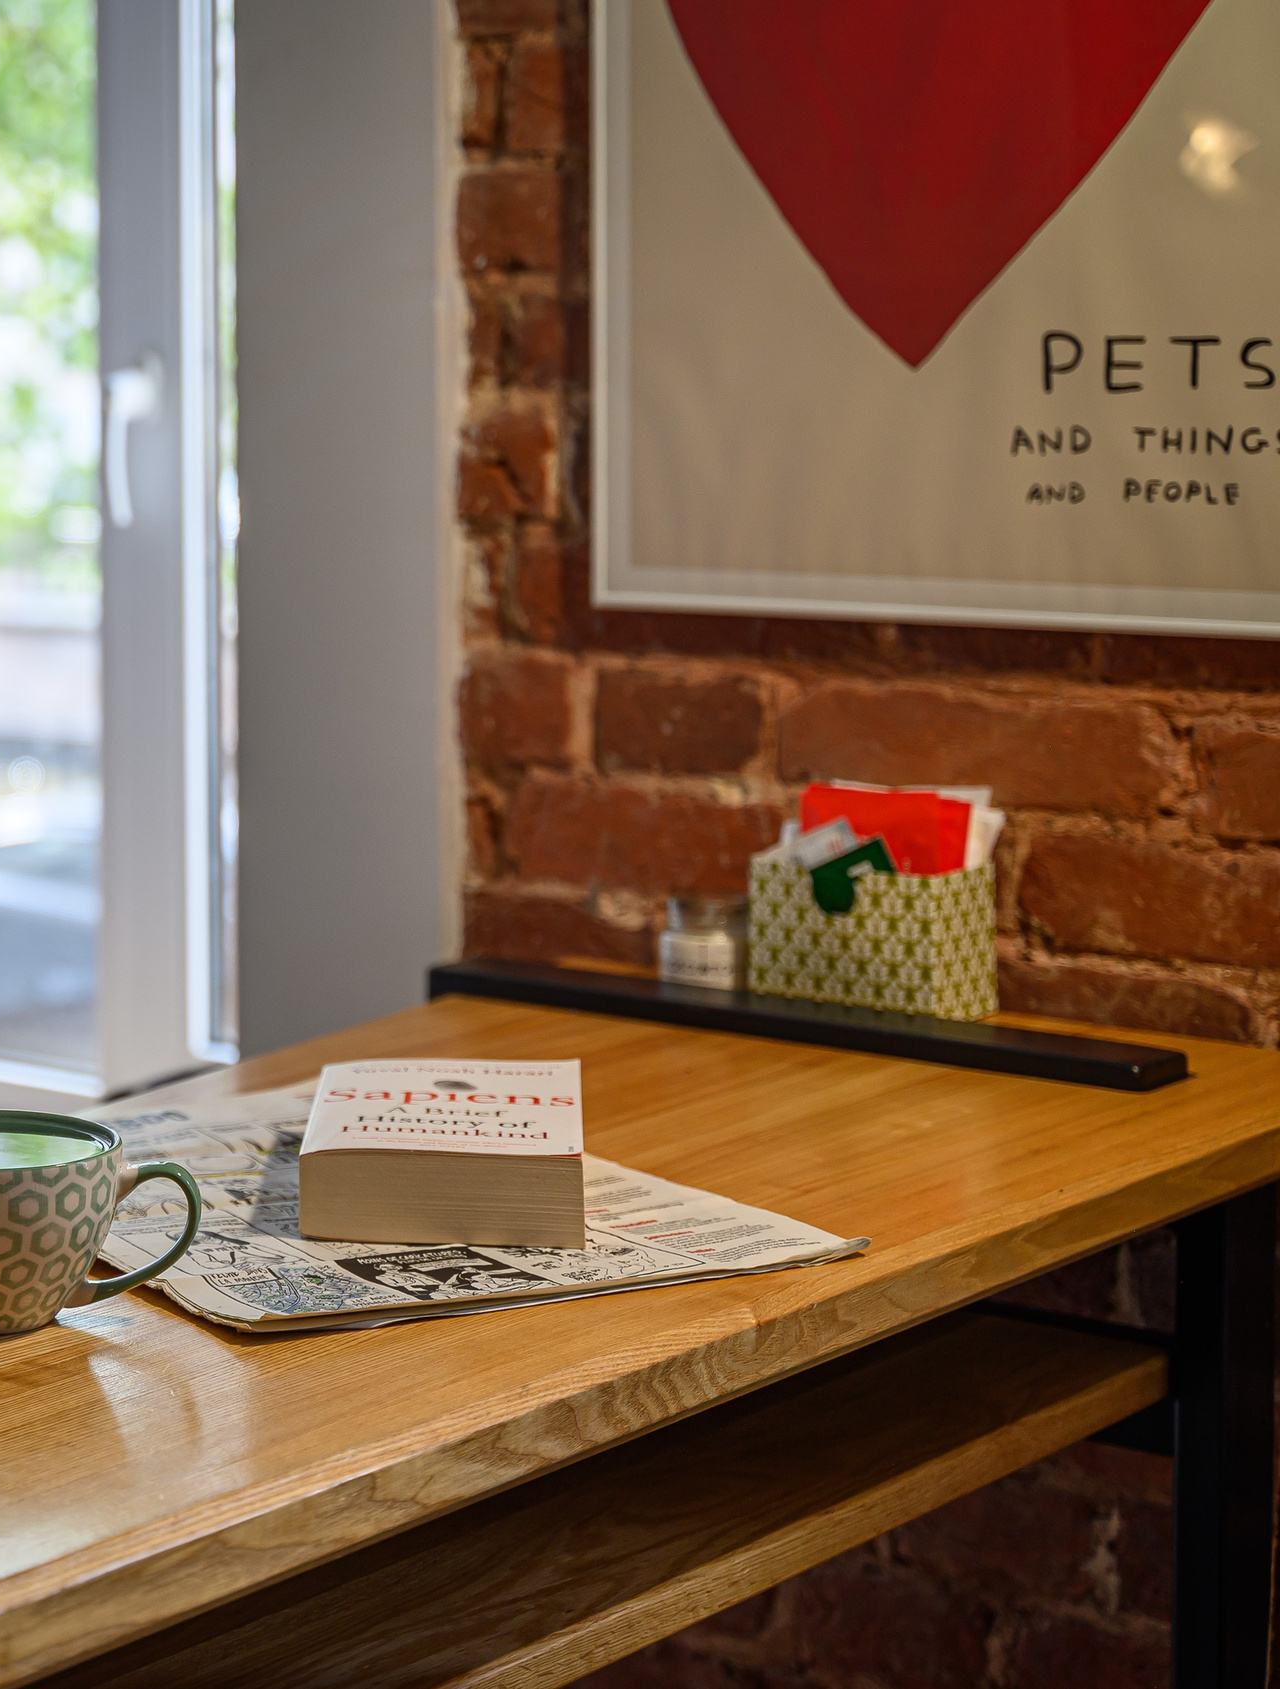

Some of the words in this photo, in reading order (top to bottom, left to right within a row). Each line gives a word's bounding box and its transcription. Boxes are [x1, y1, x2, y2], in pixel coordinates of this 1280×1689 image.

[1041, 329, 1276, 395] PETS
[1011, 424, 1092, 456] AND
[1133, 424, 1280, 456] THING
[1026, 481, 1086, 505] AND
[1123, 478, 1240, 505] PEOPLE
[323, 1087, 576, 1107] Sapiens
[358, 1115, 484, 1129] History
[499, 1120, 537, 1129] of
[387, 1106, 408, 1114] A
[425, 1107, 509, 1118] Brief
[342, 1125, 550, 1140] Humankind
